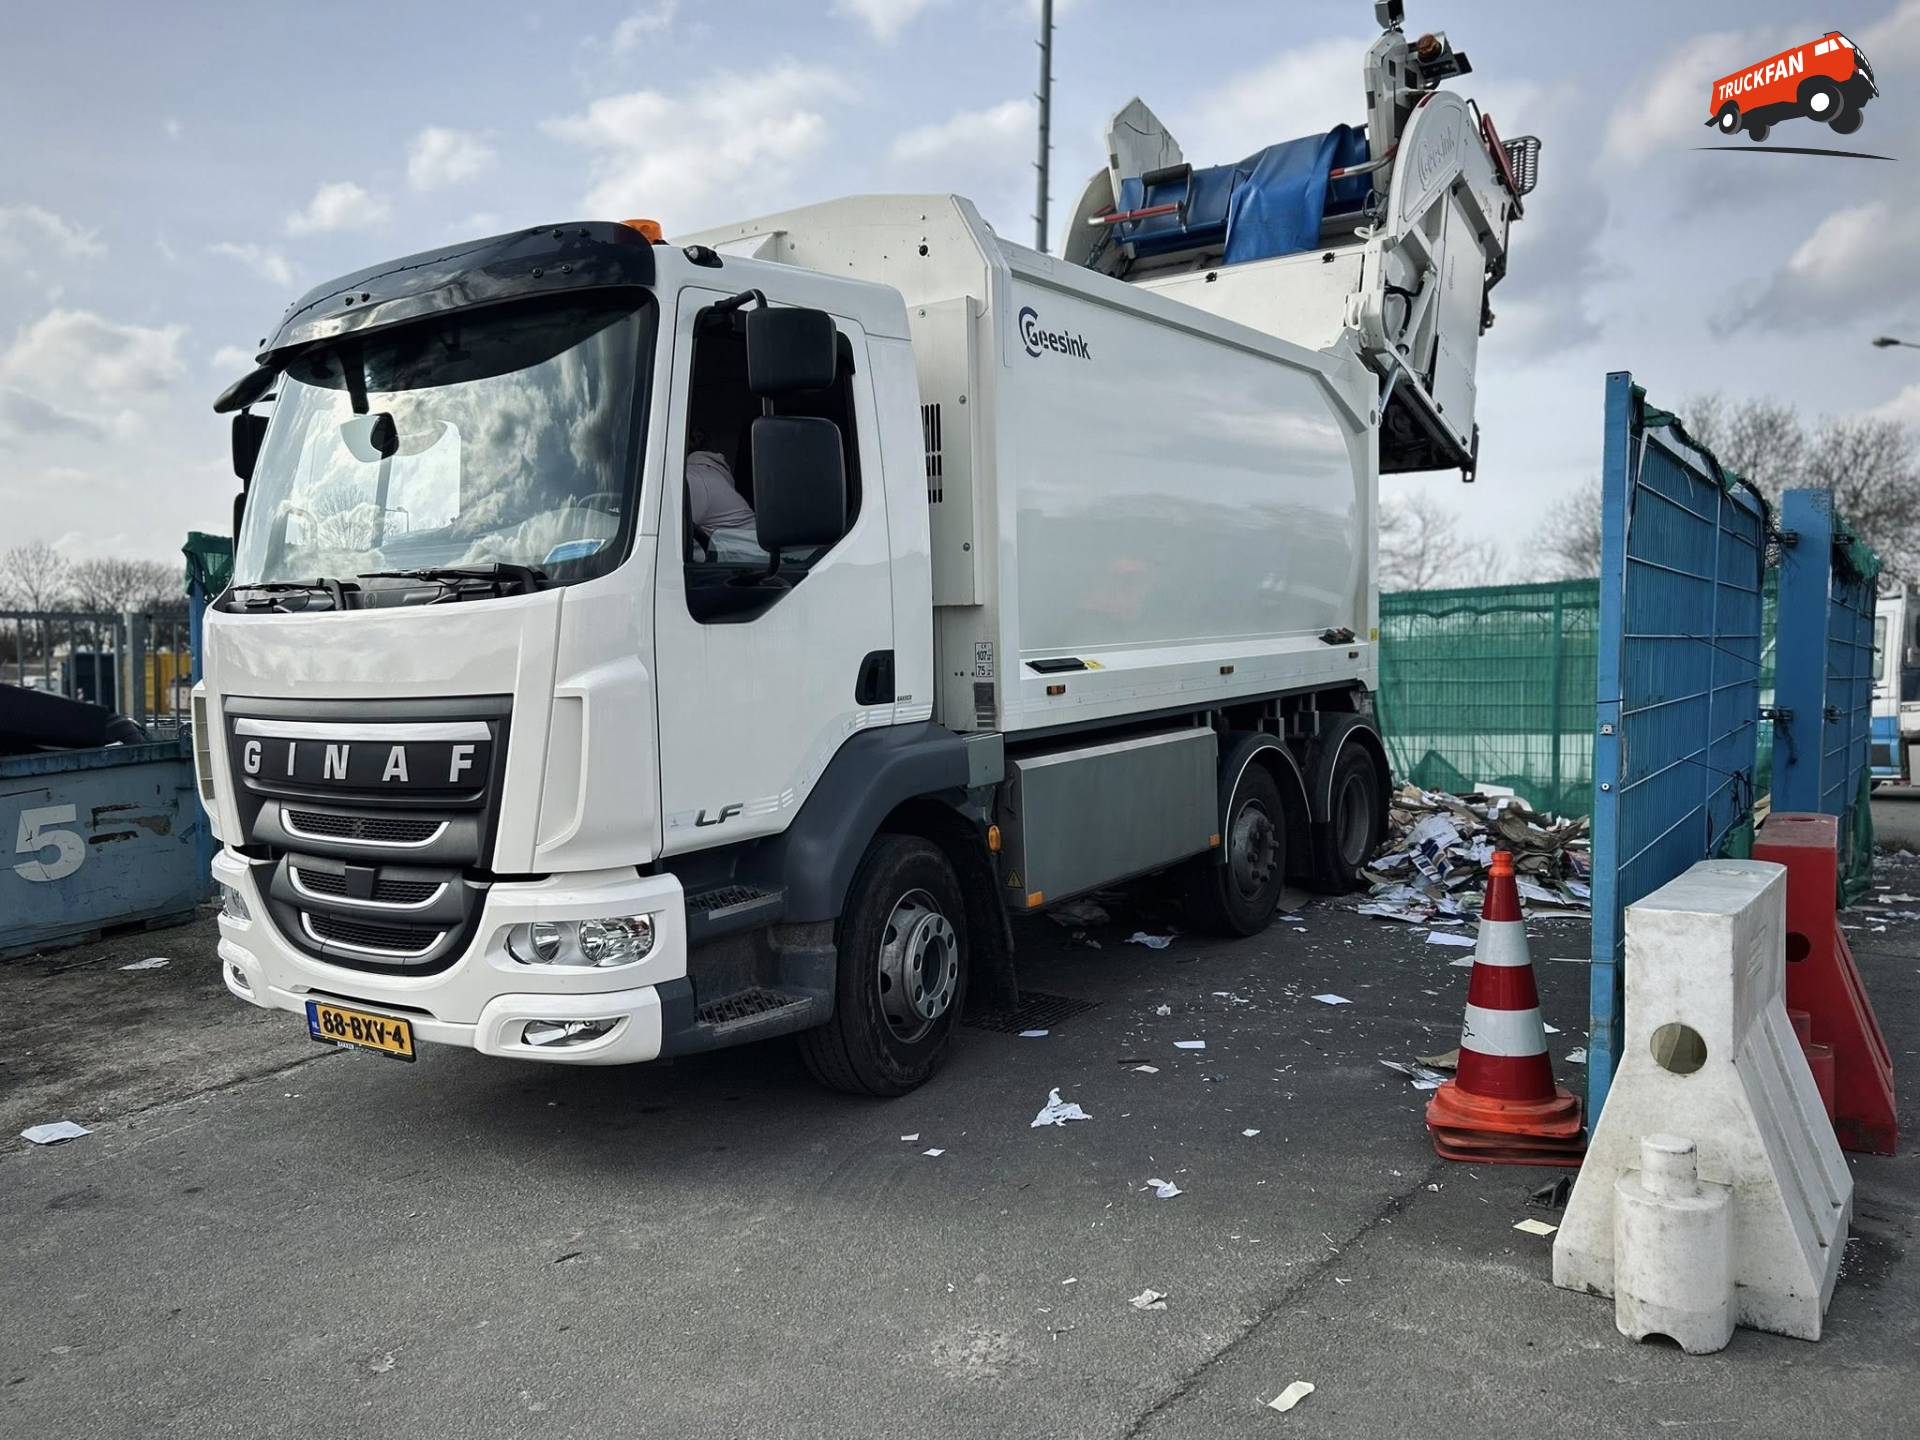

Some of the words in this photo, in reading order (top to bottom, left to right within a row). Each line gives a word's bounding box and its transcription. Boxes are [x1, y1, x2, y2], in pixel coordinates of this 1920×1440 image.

[1018, 306, 1091, 360] Geesink
[244, 741, 474, 782] GINAF
[694, 802, 743, 827] LF
[13, 803, 86, 882] 5
[322, 1009, 405, 1049] 88-BXV-4
